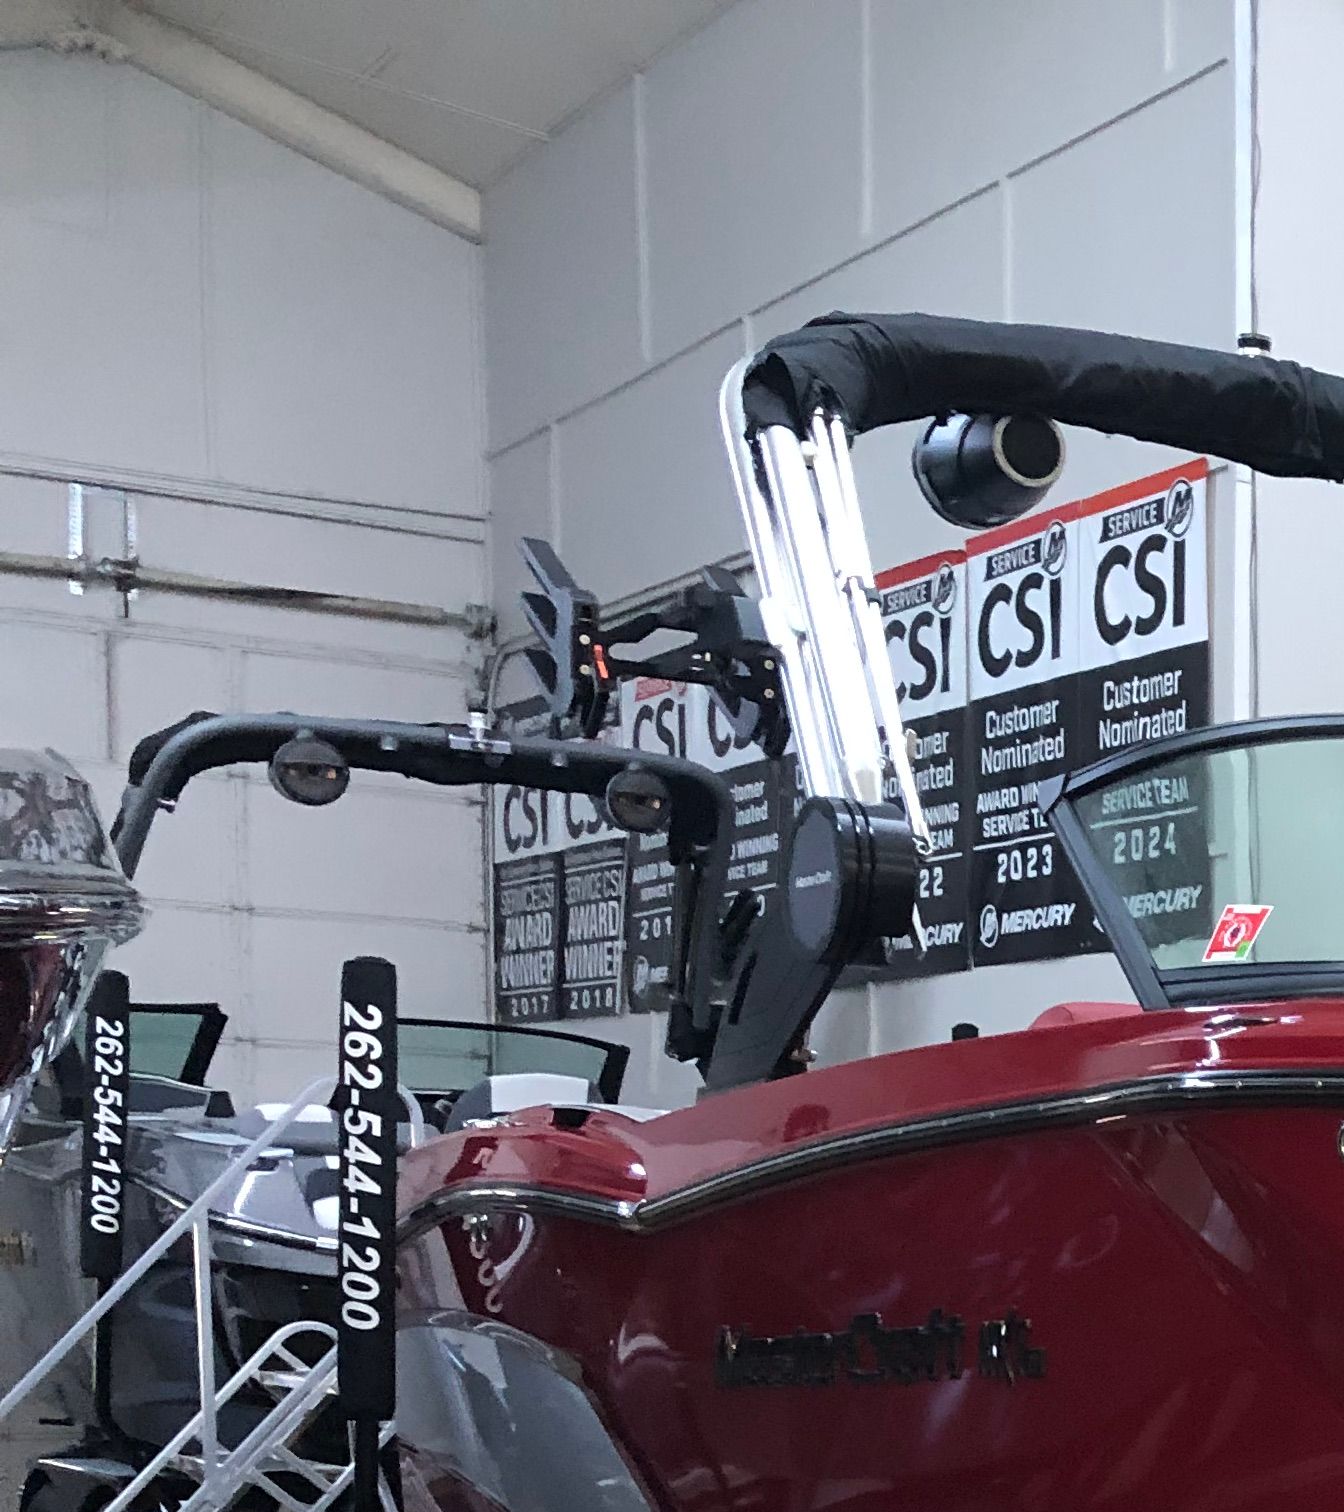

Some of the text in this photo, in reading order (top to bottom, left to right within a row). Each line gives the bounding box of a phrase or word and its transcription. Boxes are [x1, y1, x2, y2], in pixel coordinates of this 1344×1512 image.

[1108, 503, 1157, 537] SERVICE
[992, 542, 1036, 575] SERVICE
[887, 583, 927, 614] SERVICE
[1094, 533, 1186, 646] CSI
[978, 572, 1062, 678] CSI
[885, 610, 951, 704] CSI
[1103, 668, 1182, 711] Customer
[985, 700, 1060, 739] Customer
[1100, 699, 1186, 750] Nominated
[981, 728, 1065, 775] Nominated
[976, 787, 1020, 814] AWARD
[1102, 776, 1189, 814] SERVICE TEAM
[503, 785, 549, 854] CSI
[982, 810, 1029, 838] SERVICE
[931, 828, 954, 851] EAM
[1114, 822, 1177, 864] 2024
[919, 866, 944, 898] 22
[997, 845, 1052, 883] 2023
[503, 911, 553, 952] AWARD
[567, 900, 619, 942] AWARD
[639, 916, 672, 940] 201
[925, 922, 964, 946] CURY
[1001, 903, 1076, 935] MERCURY
[500, 950, 555, 989] WINNER
[564, 941, 620, 981] WINNER
[511, 994, 549, 1017] 2017
[570, 987, 613, 1010] 2018
[91, 1015, 124, 1235] 262-544-1200
[341, 1000, 384, 1331] 262-544-1200
